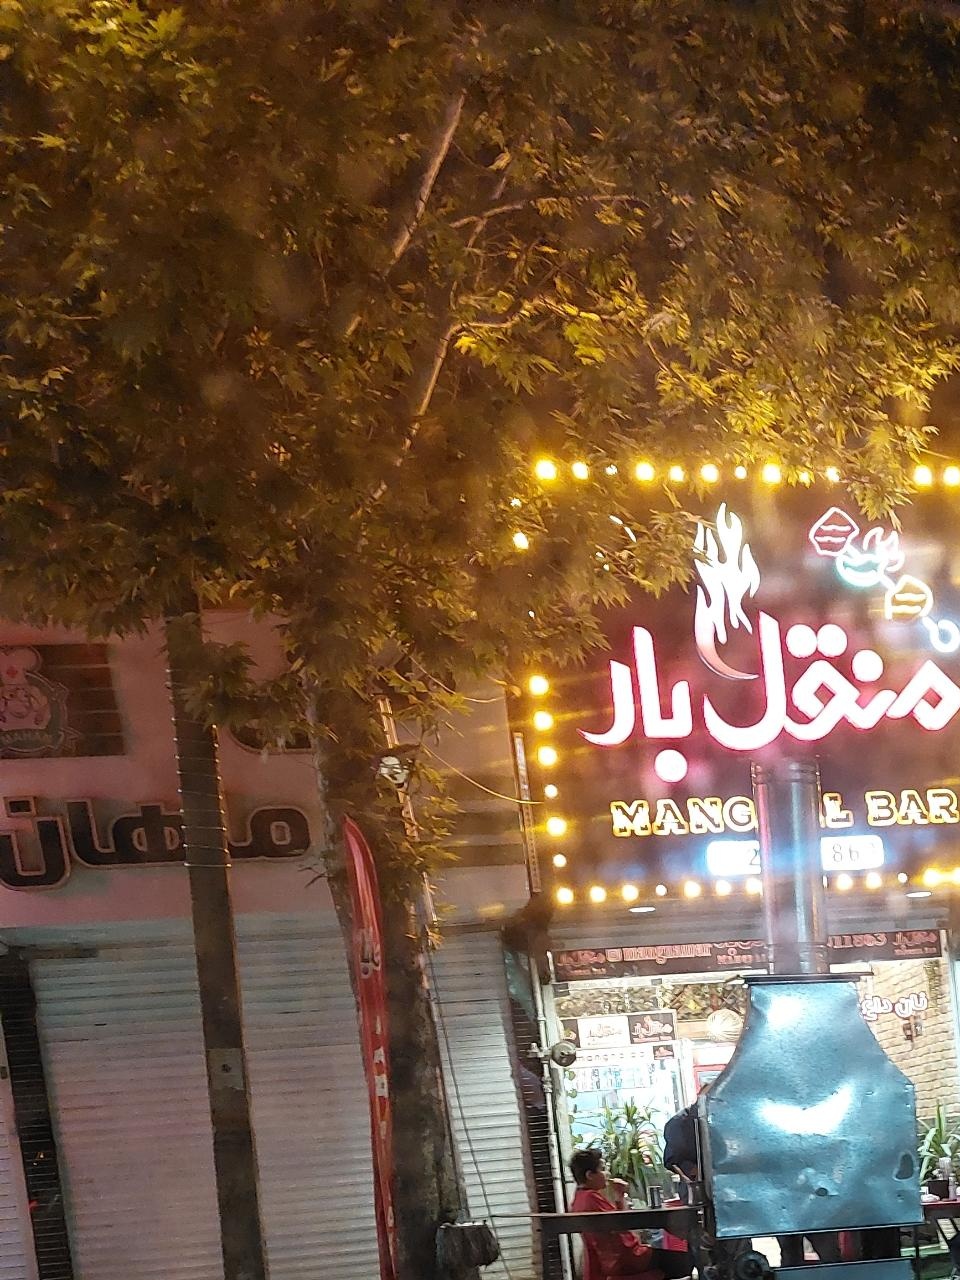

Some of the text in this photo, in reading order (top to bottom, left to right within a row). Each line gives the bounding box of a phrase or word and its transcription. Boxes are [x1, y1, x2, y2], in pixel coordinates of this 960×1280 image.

[576, 625, 693, 783] بار
[610, 788, 960, 837] MANGL BAR
